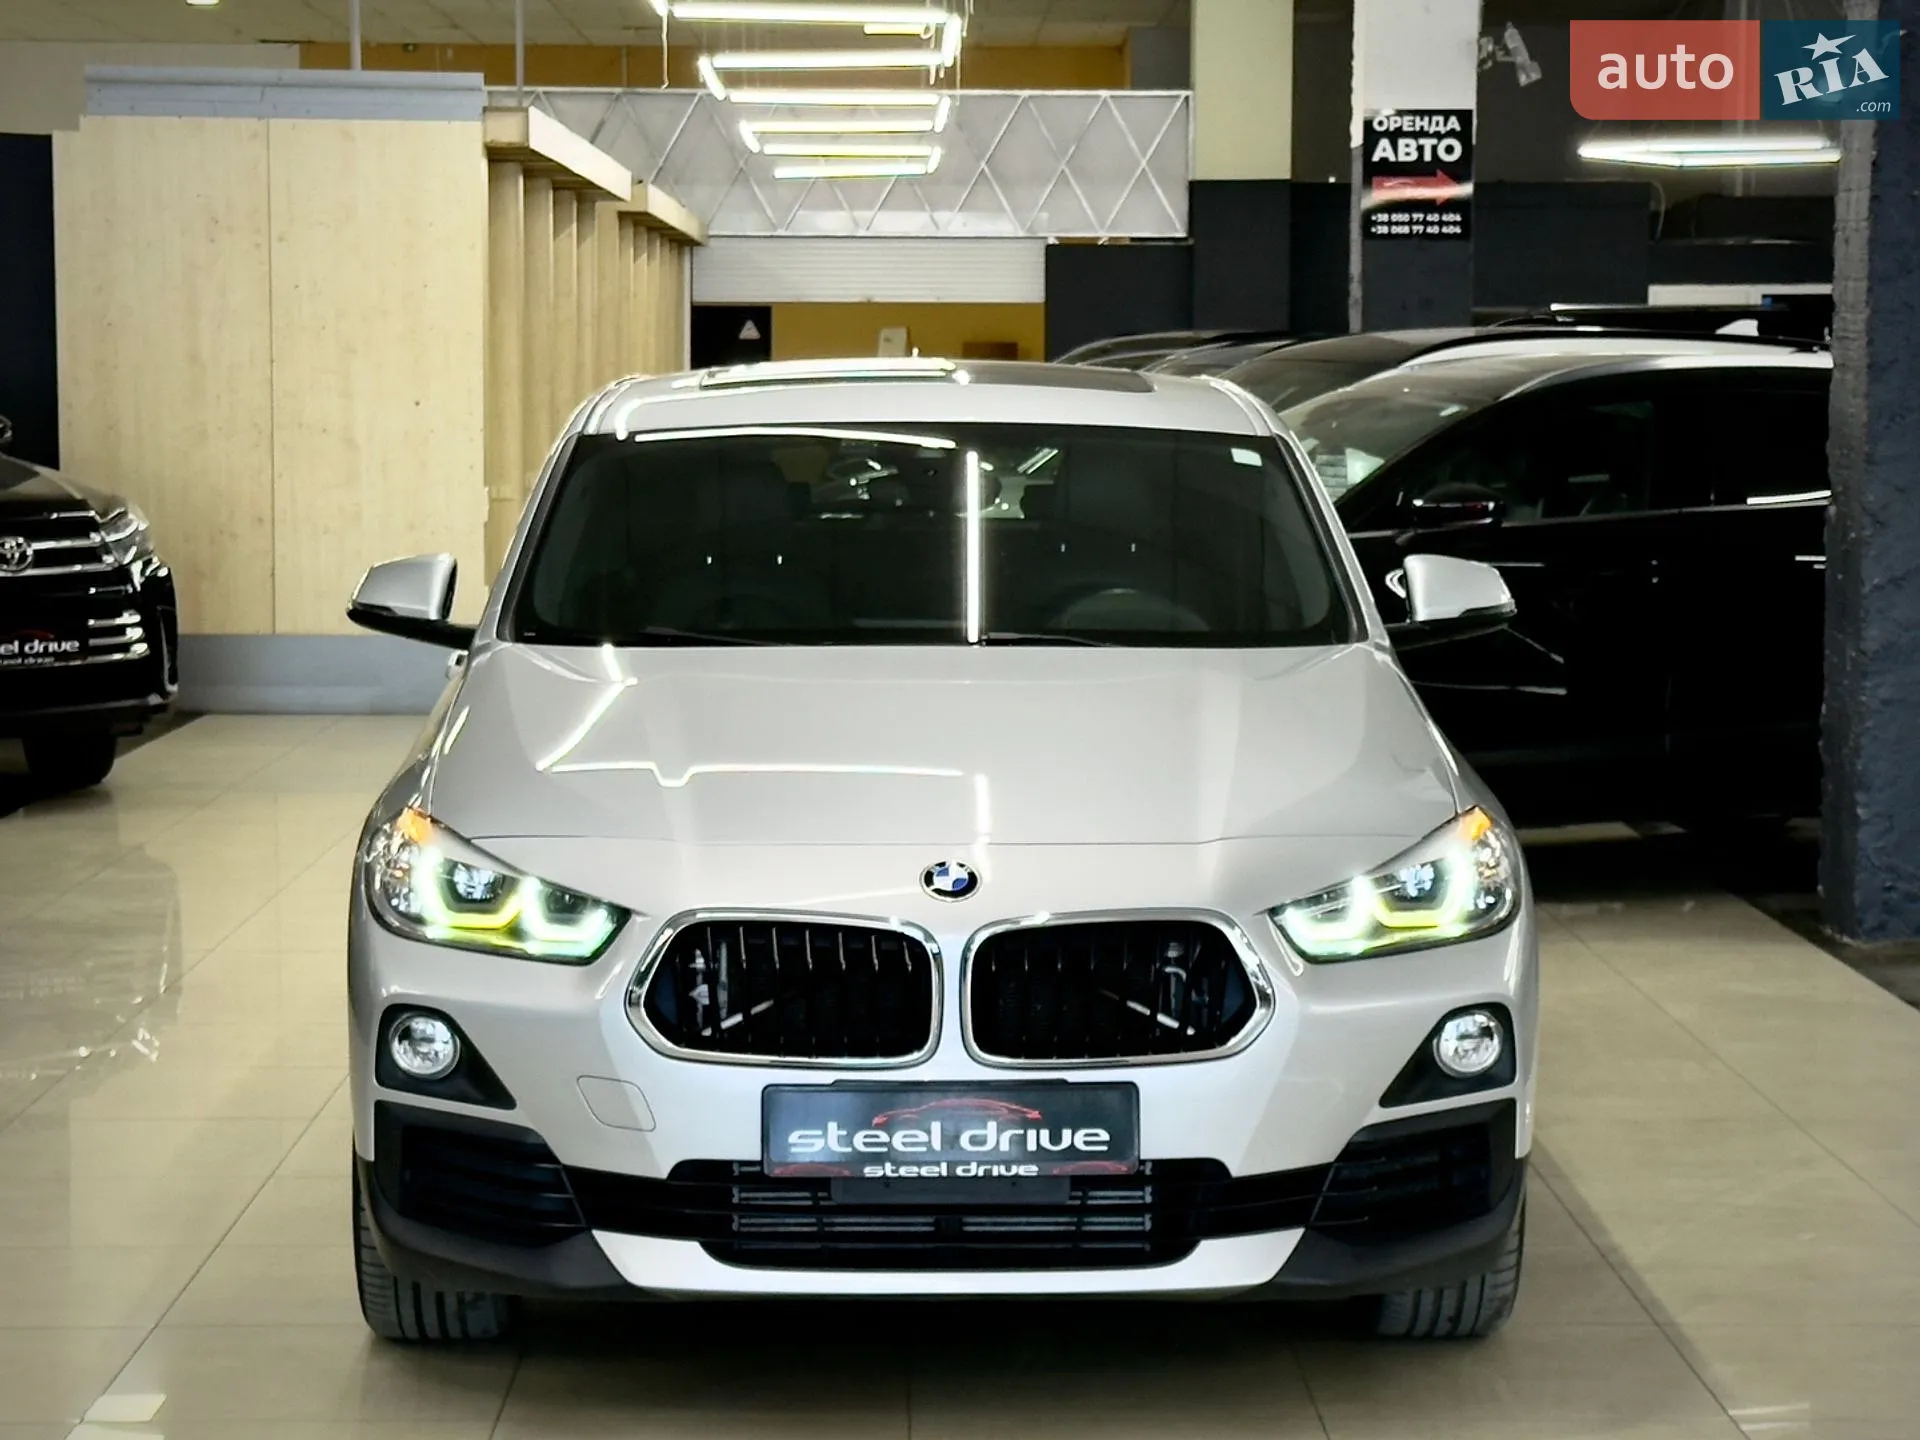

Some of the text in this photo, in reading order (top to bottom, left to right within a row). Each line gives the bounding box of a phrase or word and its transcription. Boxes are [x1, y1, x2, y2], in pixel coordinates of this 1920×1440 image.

[1372, 115, 1462, 134] ОРЕНДА
[1371, 138, 1463, 163] АВТО
[24, 639, 80, 654] drive
[788, 1121, 1111, 1152] steel drive
[863, 1162, 1040, 1178] steel drive
